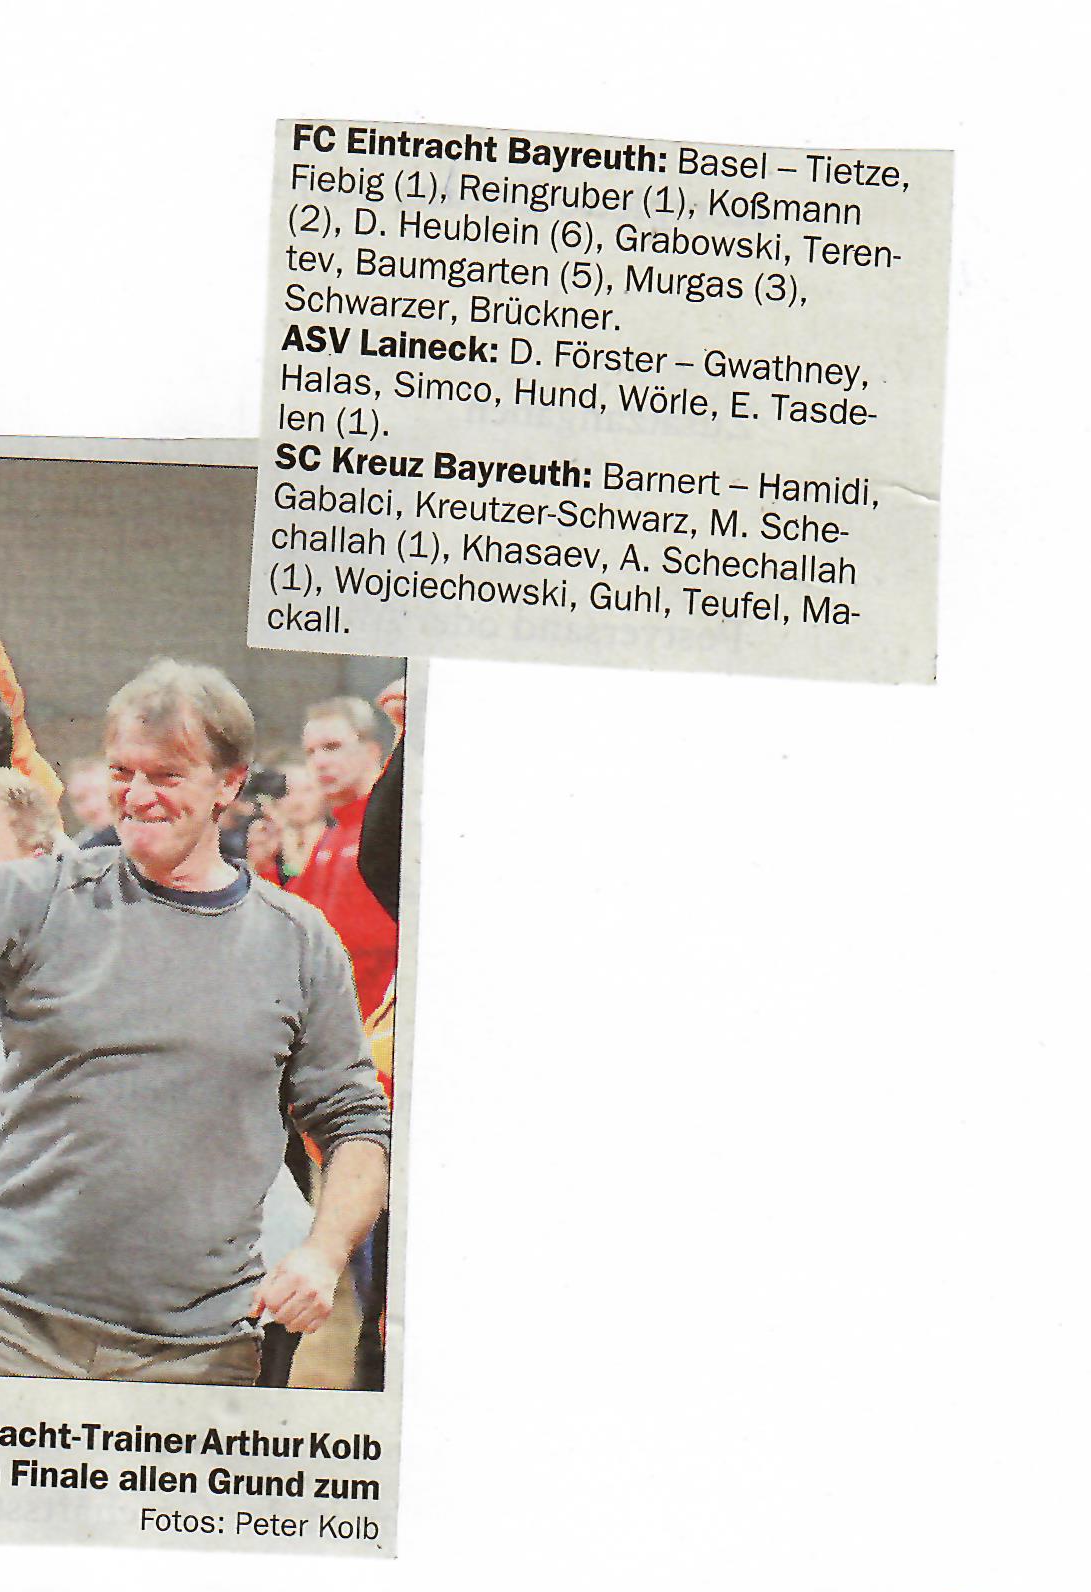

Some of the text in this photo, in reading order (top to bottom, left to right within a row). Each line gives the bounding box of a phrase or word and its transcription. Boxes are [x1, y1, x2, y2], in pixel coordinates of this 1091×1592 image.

[291, 162, 862, 227] Fiebig (1), Reingruber (1), Koßmann
[284, 244, 808, 309] tev, Baumgarten (5), Murgas (3),
[283, 282, 621, 332] Schwarzer, Brückner.
[278, 402, 390, 443] len (1).
[280, 362, 878, 427] Halas, Simco, Hund, Wörle, E. Tasde-
[273, 441, 322, 473] SC
[331, 445, 425, 479] Kreuz
[433, 450, 593, 490] Bayreuth:
[602, 461, 722, 497] Barnert
[758, 471, 880, 511] Hamidi,
[273, 480, 850, 545] Gabalci, Kreutzer-Schwarz, M. Sche-
[266, 601, 351, 635] ckall.
[269, 561, 862, 627] (1), Wojciechowski, Guhl, Teufel, Ma-
[199, 1427, 305, 1459] Arthur
[308, 1431, 383, 1462] Kolb
[10, 1458, 110, 1491] Finale
[117, 1464, 198, 1495] allen
[207, 1466, 305, 1499] Grund
[312, 1477, 381, 1502] zum
[140, 1506, 225, 1535] Fotos:
[235, 1510, 310, 1538] Peter
[318, 1513, 380, 1541] Kolb
